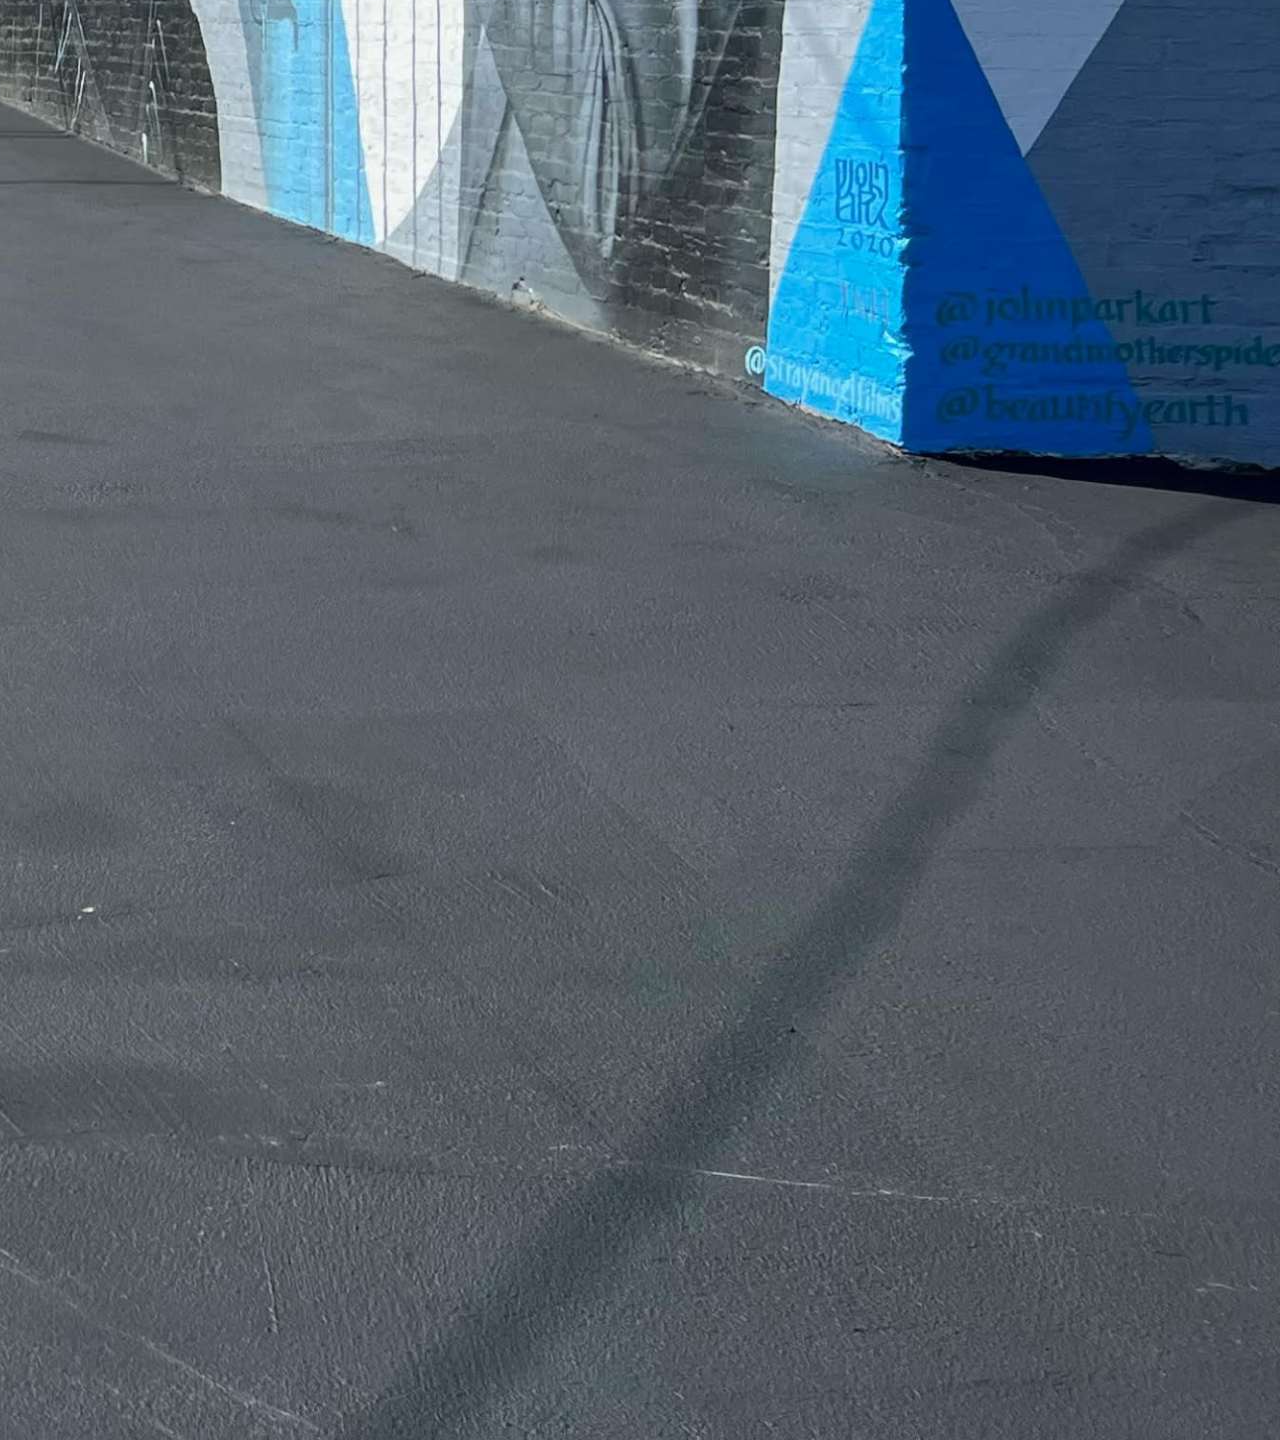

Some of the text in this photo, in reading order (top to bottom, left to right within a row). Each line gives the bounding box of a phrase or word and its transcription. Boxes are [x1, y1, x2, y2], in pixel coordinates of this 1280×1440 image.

[936, 283, 1219, 326] @johnparkart
[744, 345, 902, 423] @strayangelfilms
[935, 384, 1251, 441] @beautifyearth
